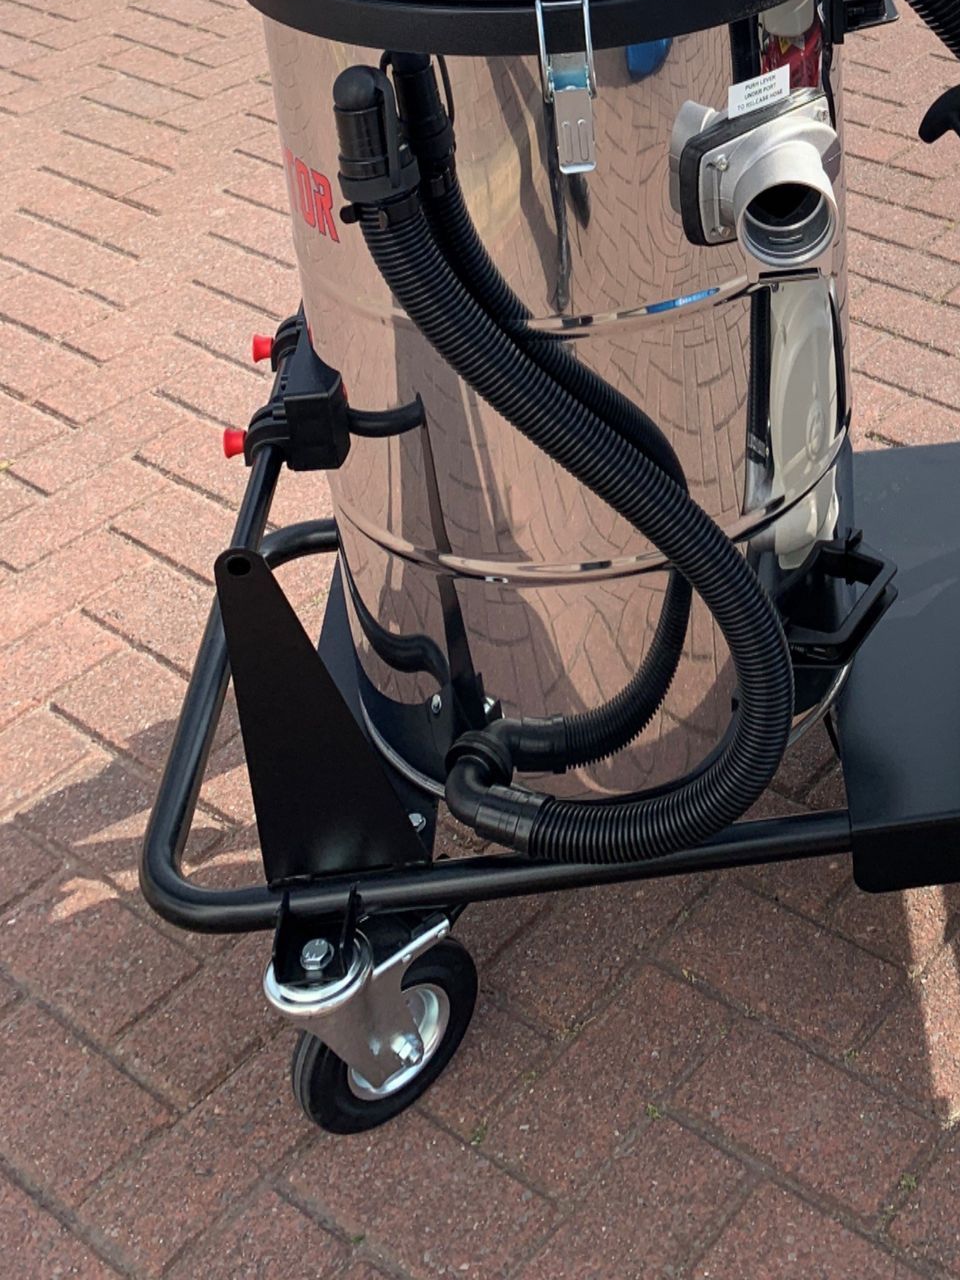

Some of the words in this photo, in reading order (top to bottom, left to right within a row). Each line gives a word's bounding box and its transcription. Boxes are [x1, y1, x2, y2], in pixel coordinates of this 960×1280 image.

[744, 82, 759, 92] PUSH
[760, 75, 776, 85] LEVER
[744, 89, 763, 100] UNDER
[763, 83, 777, 92] PORT
